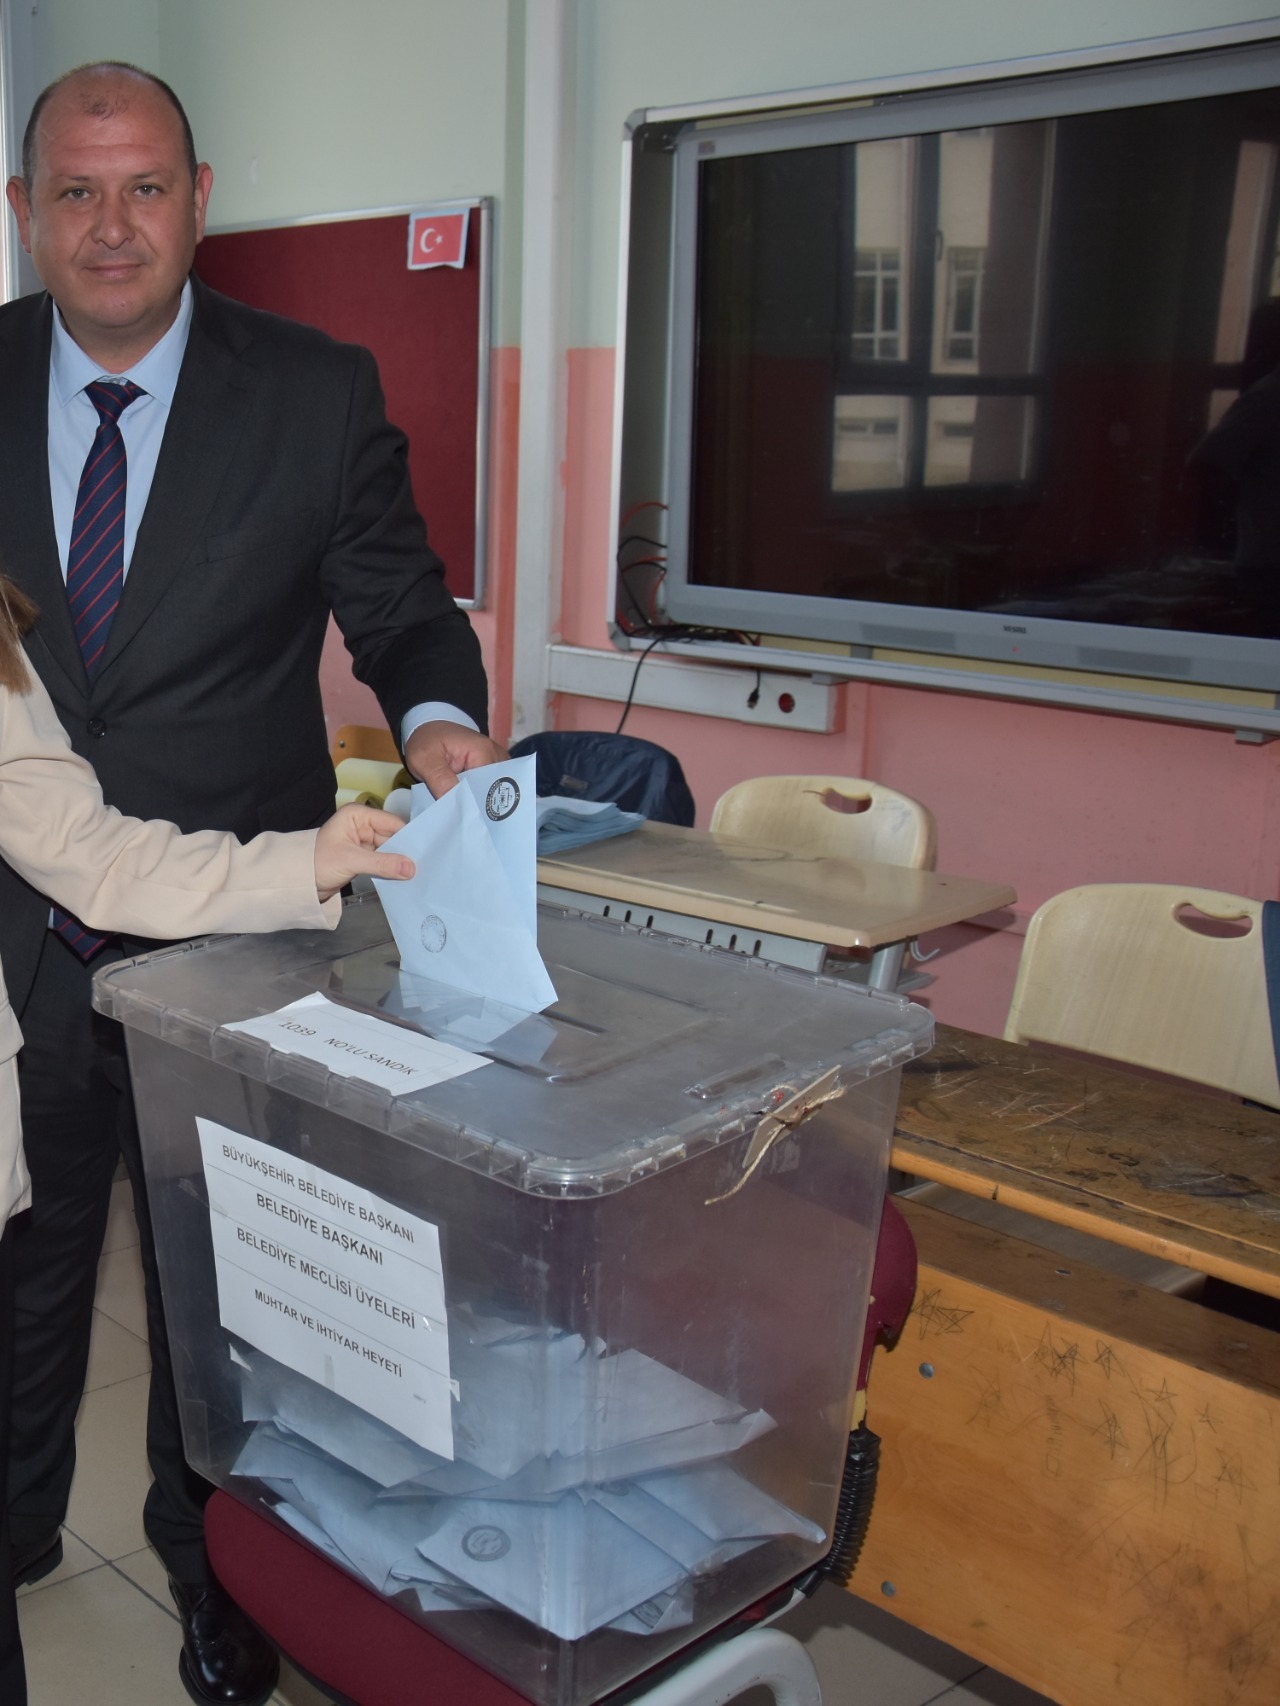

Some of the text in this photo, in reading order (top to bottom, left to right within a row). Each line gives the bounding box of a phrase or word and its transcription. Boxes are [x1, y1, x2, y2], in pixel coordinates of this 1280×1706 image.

[278, 1021, 317, 1036] 1039
[363, 1053, 418, 1075] SANDIK
[222, 1144, 414, 1243] BÜYÜKŞEHİR BELEDİYE BAŞKANI
[256, 1193, 383, 1265] BELEDİYE BAŞKANI
[237, 1227, 415, 1329] BELEDİYE MECLİSİ ÜYELERİ
[255, 1289, 402, 1378] MUHTAR VE İHTİYAR HEYETİ
